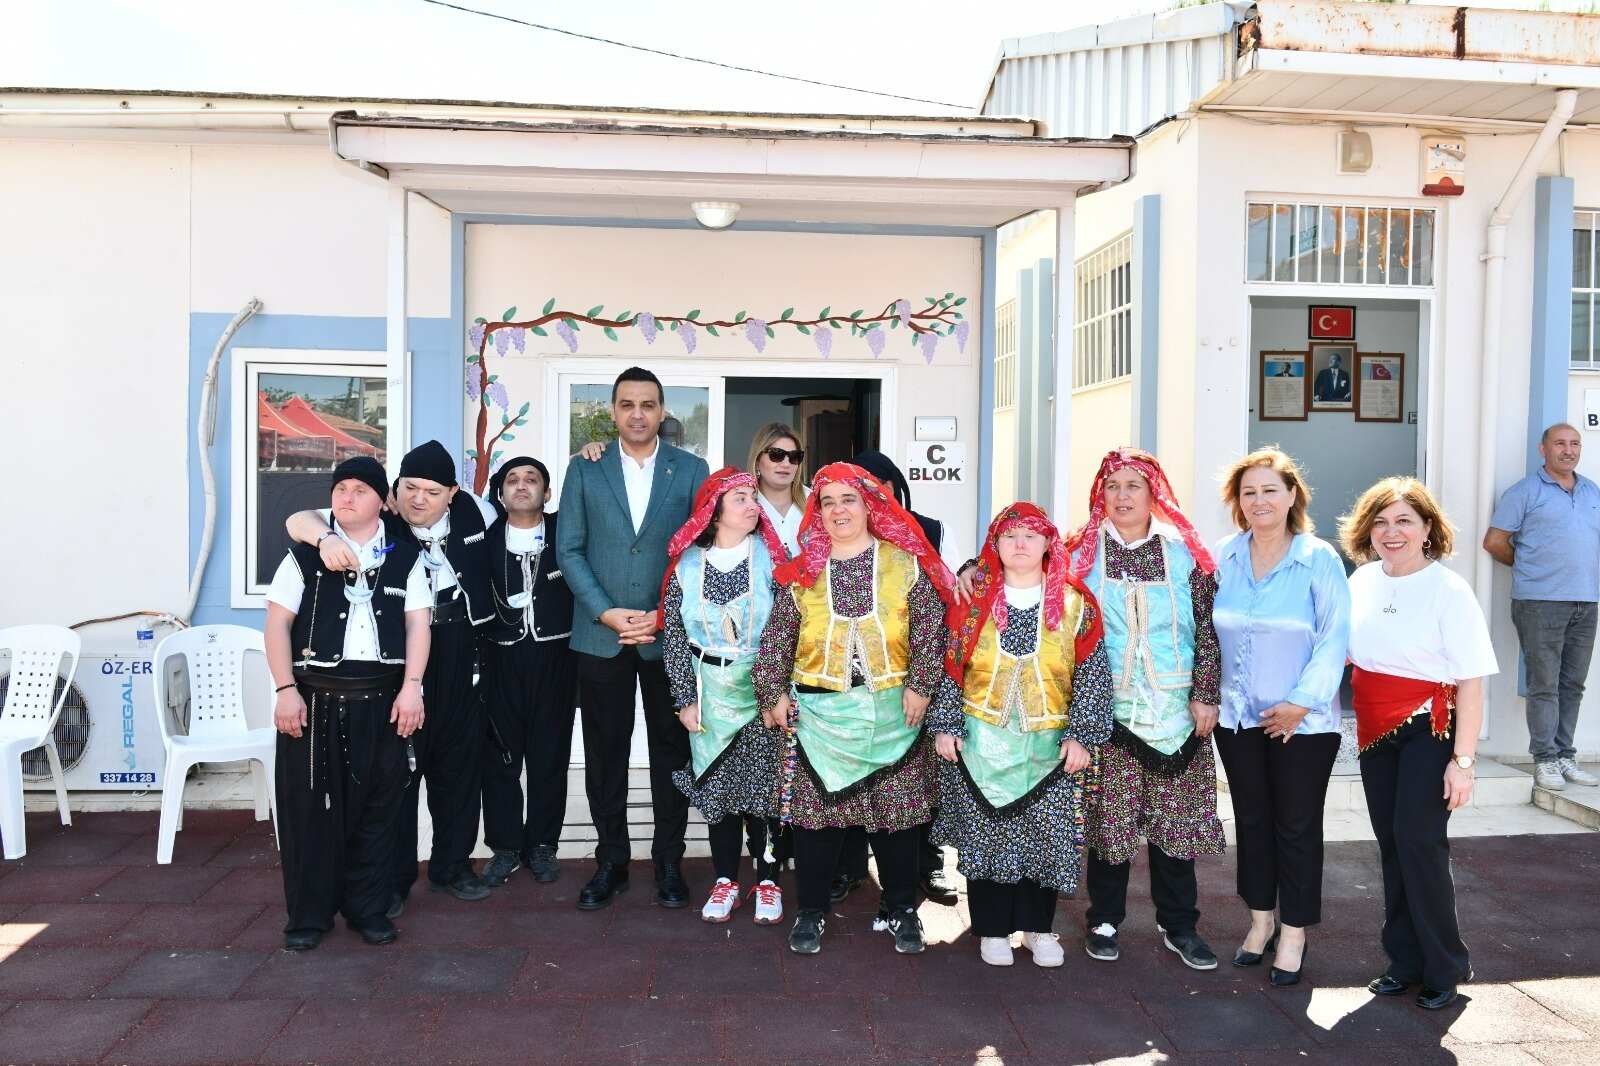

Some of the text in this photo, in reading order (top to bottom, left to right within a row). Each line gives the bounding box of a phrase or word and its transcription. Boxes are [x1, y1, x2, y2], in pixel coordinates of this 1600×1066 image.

[926, 444, 946, 465] C
[909, 467, 961, 481] BLOK
[121, 675, 135, 749] REGAL
[103, 773, 122, 783] 337
[125, 773, 138, 783] 14
